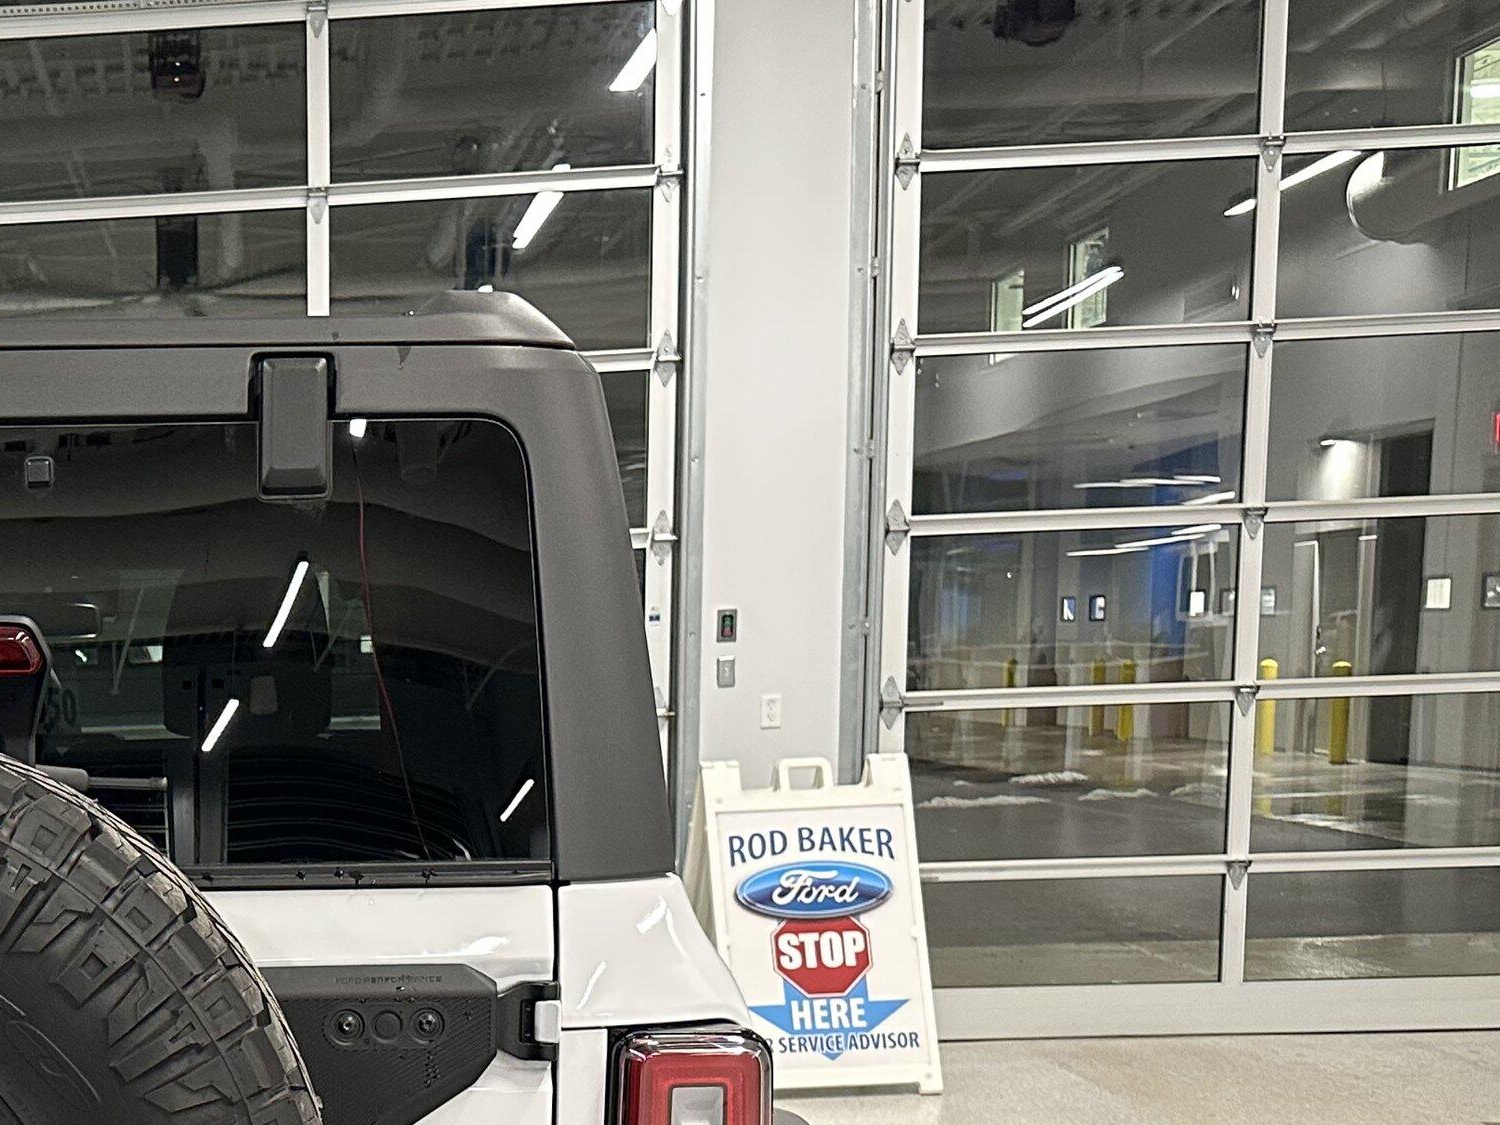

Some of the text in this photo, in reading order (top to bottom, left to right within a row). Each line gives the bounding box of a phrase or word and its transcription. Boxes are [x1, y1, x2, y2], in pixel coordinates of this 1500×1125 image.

[729, 827, 895, 866] ROD BAKER
[772, 869, 860, 906] Ford
[777, 930, 866, 971] STOP
[790, 997, 868, 1031] HERE
[779, 1034, 844, 1053] SERVICE
[848, 1031, 920, 1050] ADVISOR
